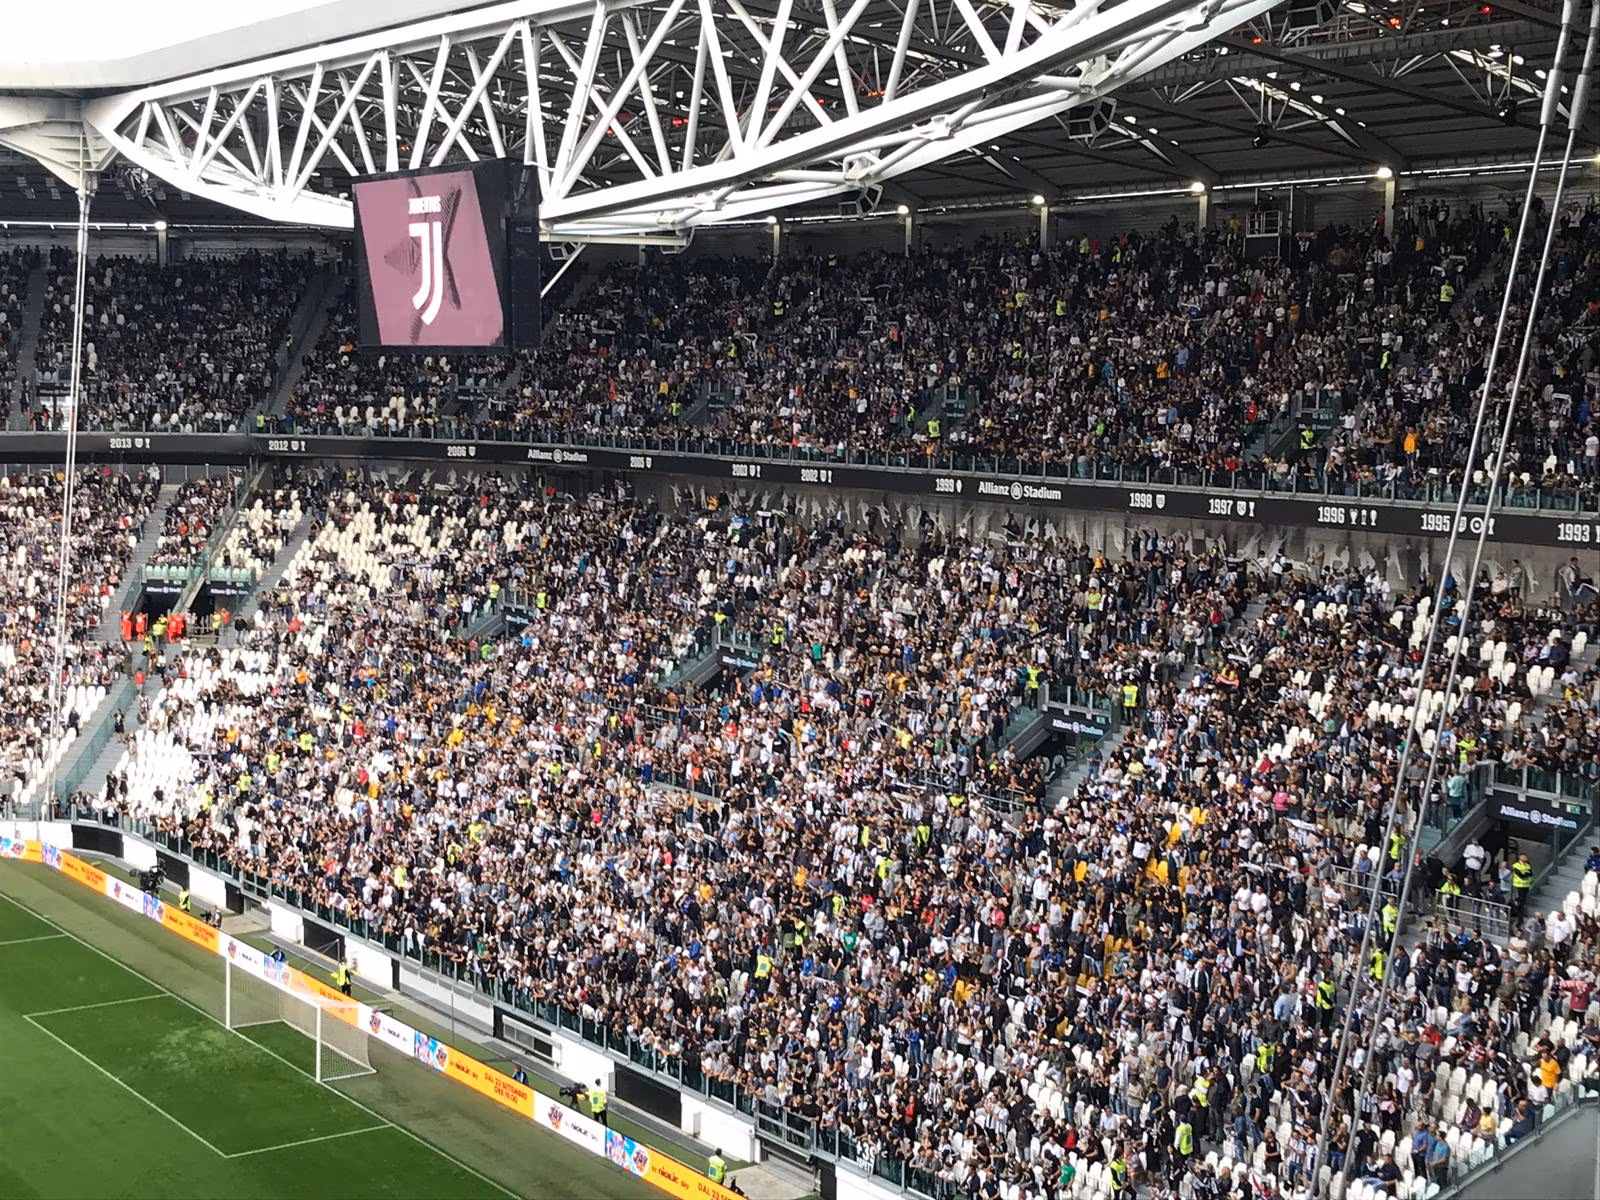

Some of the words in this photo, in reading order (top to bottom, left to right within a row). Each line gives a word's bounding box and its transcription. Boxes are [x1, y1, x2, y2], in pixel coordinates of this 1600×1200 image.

[110, 438, 132, 449] 2013
[268, 440, 289, 451] 2012
[447, 445, 467, 457] 2006
[527, 448, 553, 461] Allianz
[562, 451, 588, 463] Stadium
[935, 478, 955, 493] 1999
[978, 481, 1010, 496] Allianz
[1023, 485, 1062, 500] Stadium
[1129, 492, 1153, 509] 1998
[1208, 498, 1234, 515] 1997
[1317, 506, 1345, 524] 1996
[1420, 513, 1451, 532] 1995
[1557, 523, 1590, 543] 1993
[1500, 805, 1530, 820] Allianz
[1541, 813, 1577, 830] Stadium
